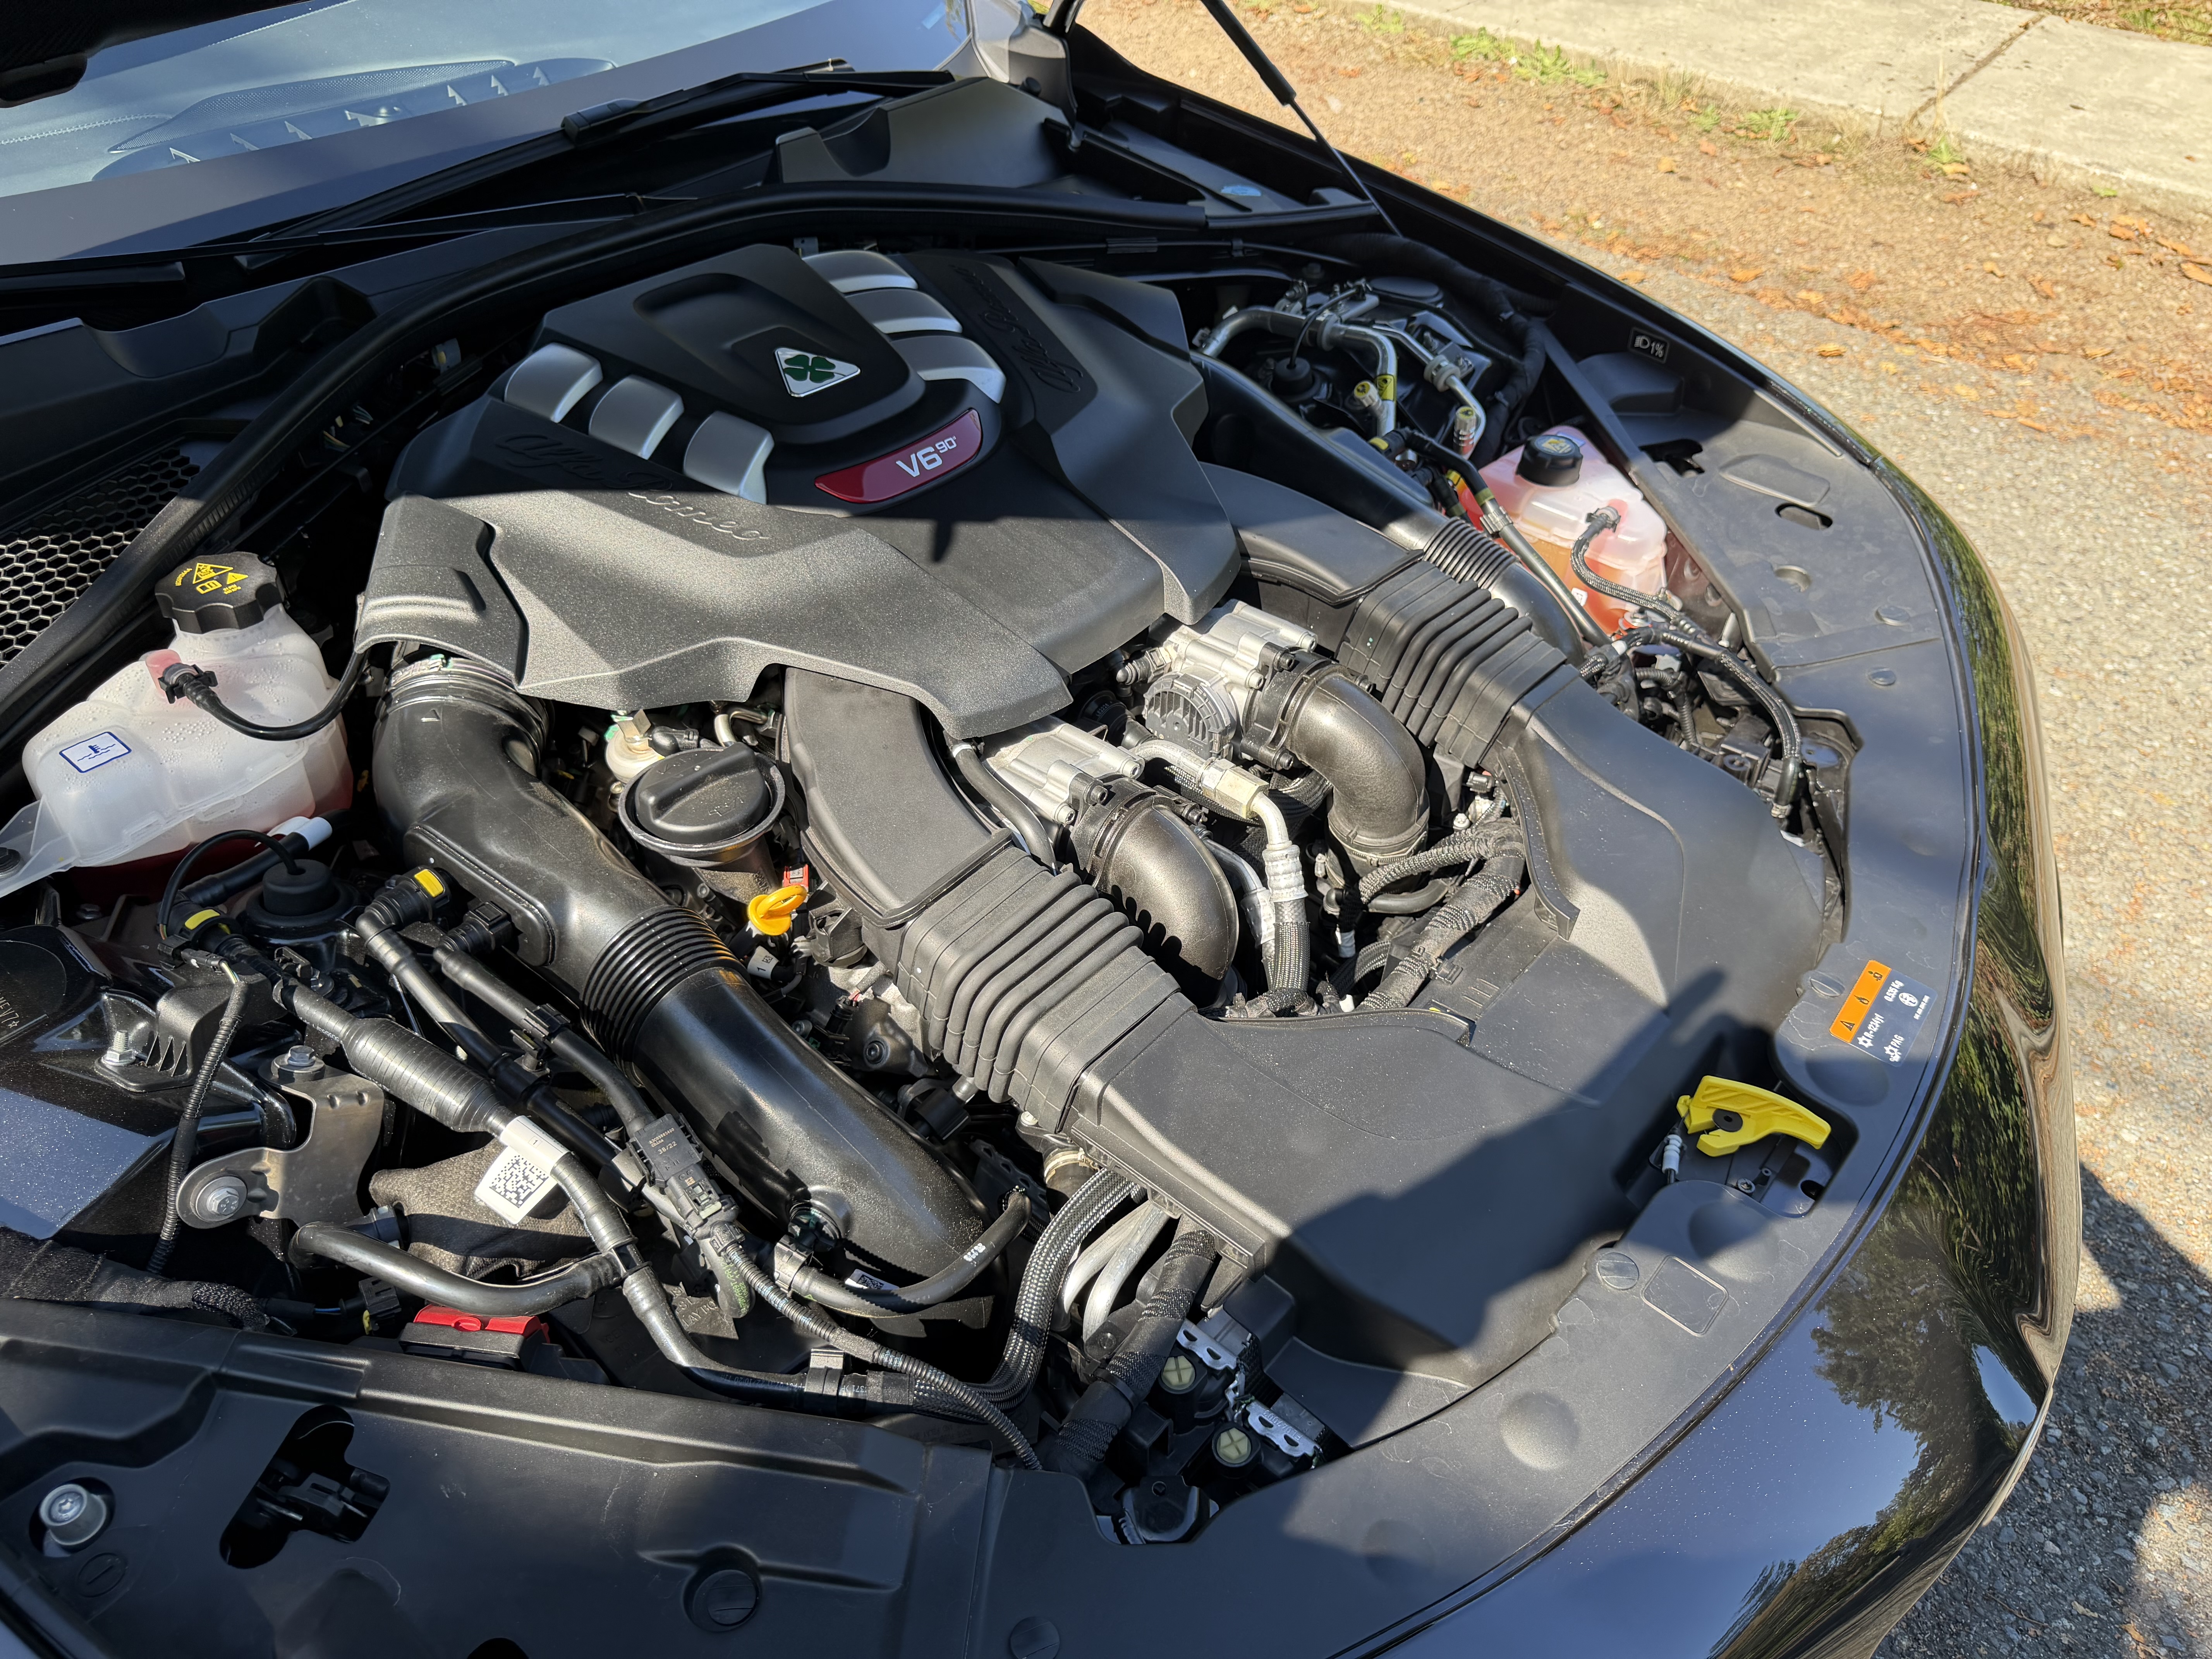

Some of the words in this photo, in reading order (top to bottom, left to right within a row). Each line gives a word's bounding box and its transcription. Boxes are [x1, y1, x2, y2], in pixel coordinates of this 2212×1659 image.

[896, 446, 942, 477] V6
[1891, 1034, 1905, 1048] PAG
[658, 1141, 677, 1154] 38/22
